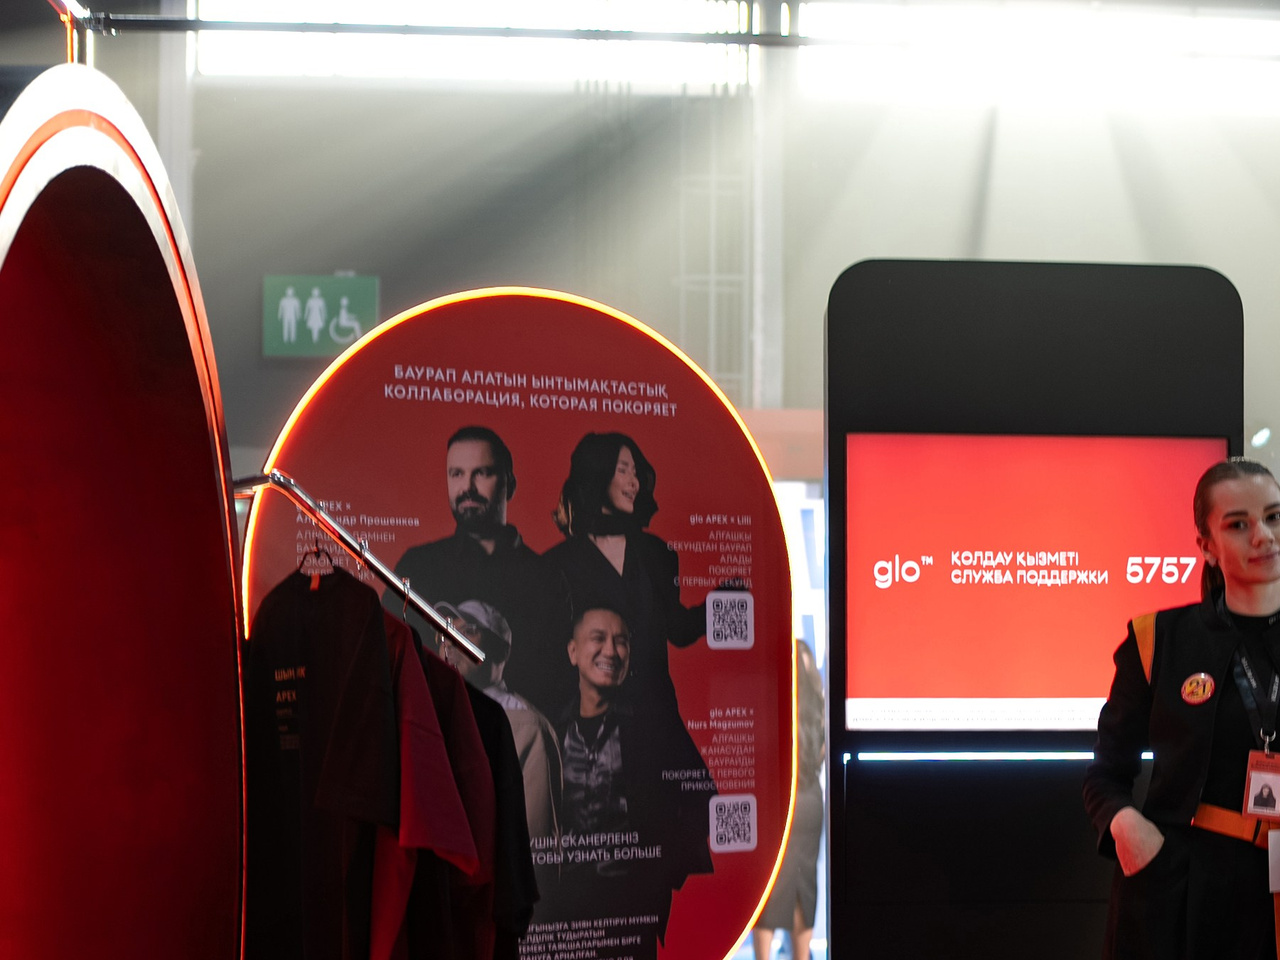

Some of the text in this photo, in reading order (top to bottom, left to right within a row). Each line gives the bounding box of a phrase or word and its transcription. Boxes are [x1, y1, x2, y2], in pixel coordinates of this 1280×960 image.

[394, 364, 668, 400] БАУРАП АЛАТЫН ЫНТЫМАҚТАСТЫҚ
[384, 384, 678, 417] КОЛЛАБОРАЦИЯ, КОТОРАЯ ПОКОРЯЕТ
[706, 514, 727, 525] APEX
[667, 541, 751, 553] СЕКУНДТАН БАУРАП
[720, 554, 752, 565] АЛАДЫ
[709, 565, 751, 576] ПОКОРЯЕТ
[1126, 556, 1197, 584] 5757
[683, 576, 716, 587] ПЕРВЫХ
[719, 577, 752, 588] СЕКУНД
[951, 569, 1109, 587] СЛУЖБА ПОДДЕРЖКИ
[688, 719, 754, 731] Nurs Magzumov
[662, 769, 707, 780] ПОКОРЯЕТ
[718, 767, 755, 778] ПЕРВОГО
[681, 780, 755, 791] ПРИКОСНОВЕНИЯ
[567, 848, 611, 863] УЗНАТЬ
[614, 845, 662, 860] БОЛЬШЕ
[621, 935, 641, 946] БІРГЕ
